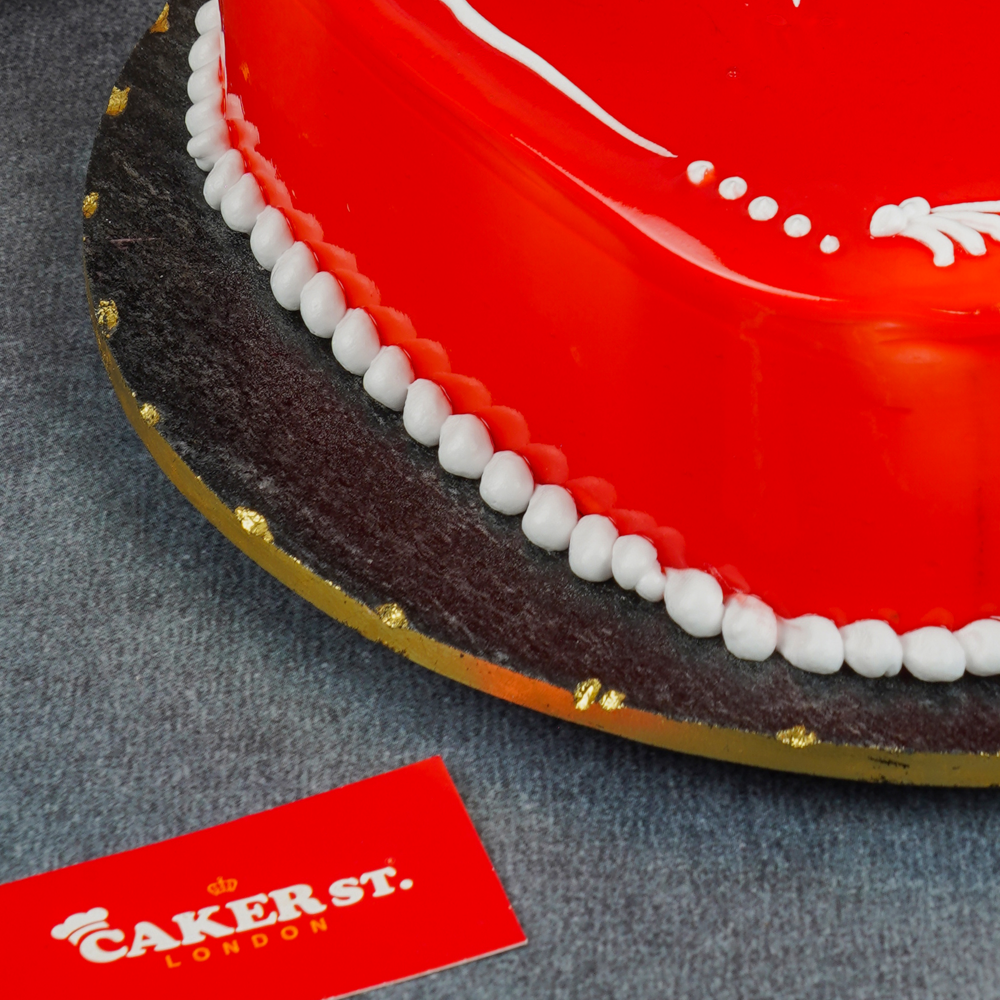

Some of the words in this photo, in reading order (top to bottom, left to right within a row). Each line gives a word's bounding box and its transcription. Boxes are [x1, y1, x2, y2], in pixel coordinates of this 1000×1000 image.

[79, 884, 327, 963] CAKER
[329, 866, 414, 907] ST.
[165, 917, 328, 969] LONDON
